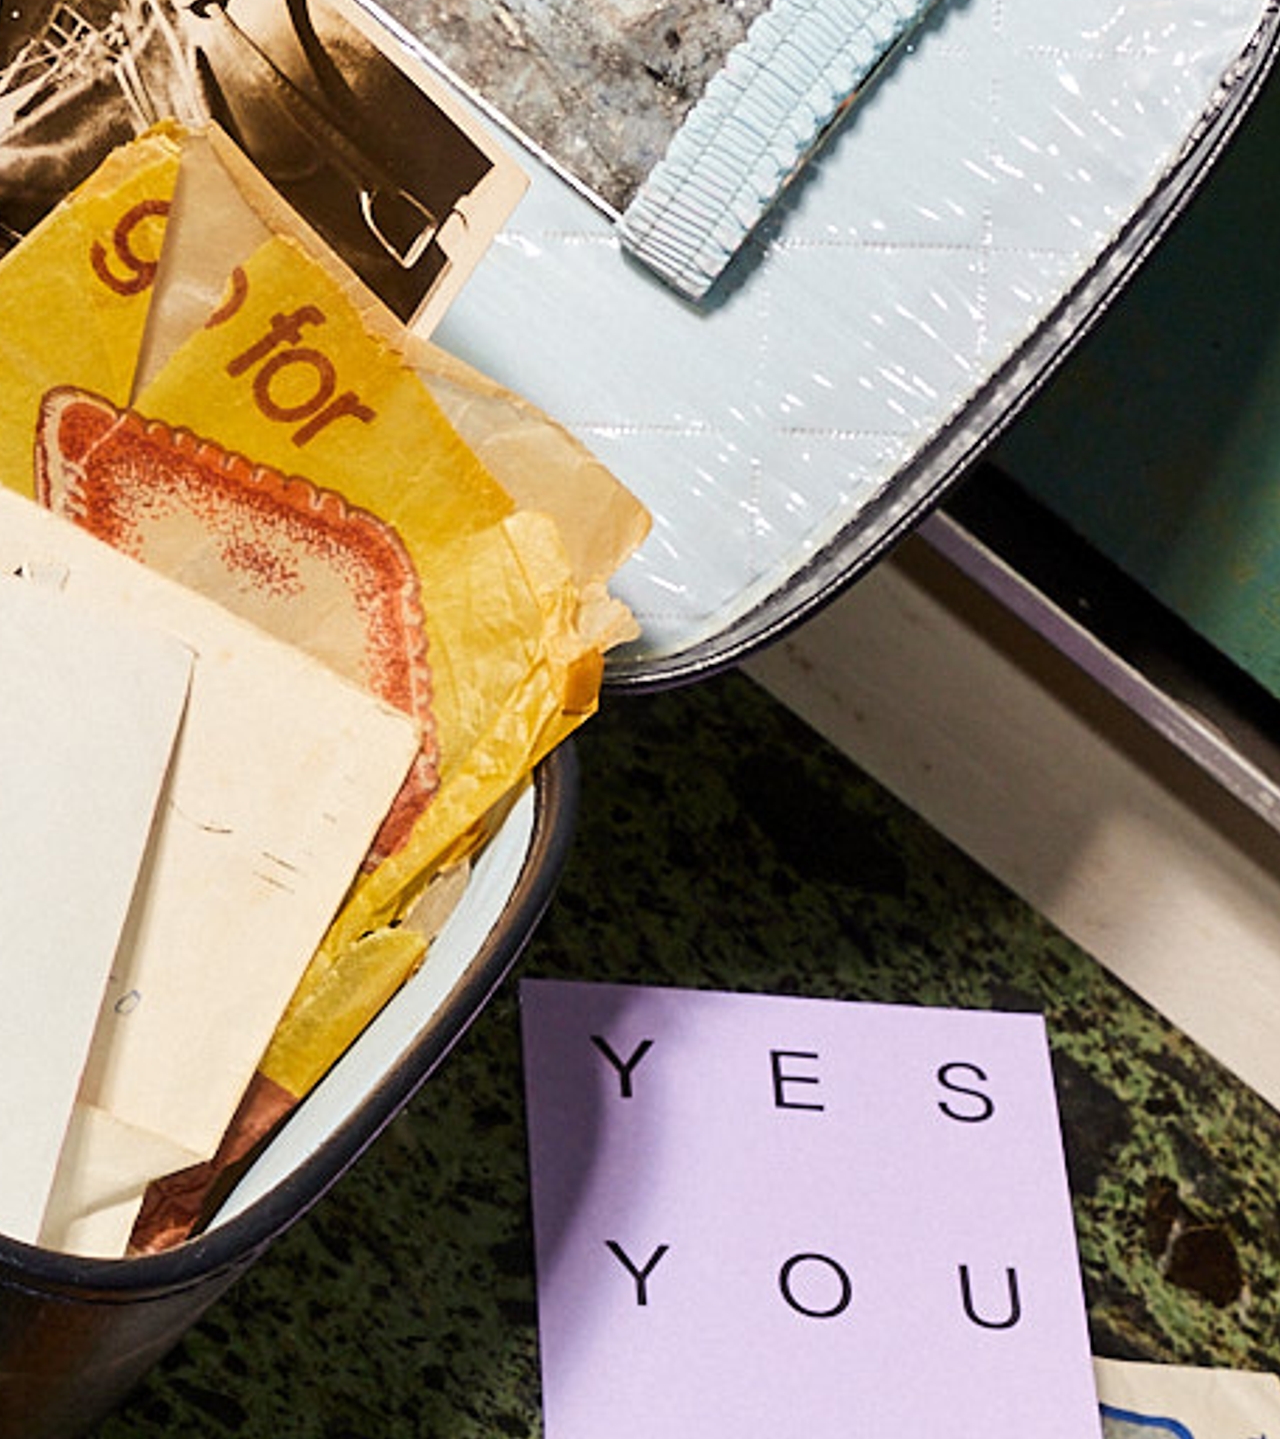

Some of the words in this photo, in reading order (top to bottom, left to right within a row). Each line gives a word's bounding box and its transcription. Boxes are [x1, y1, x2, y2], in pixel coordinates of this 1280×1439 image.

[226, 304, 376, 447] for
[591, 1035, 996, 1124] YES
[605, 1240, 1023, 1329] YOU
